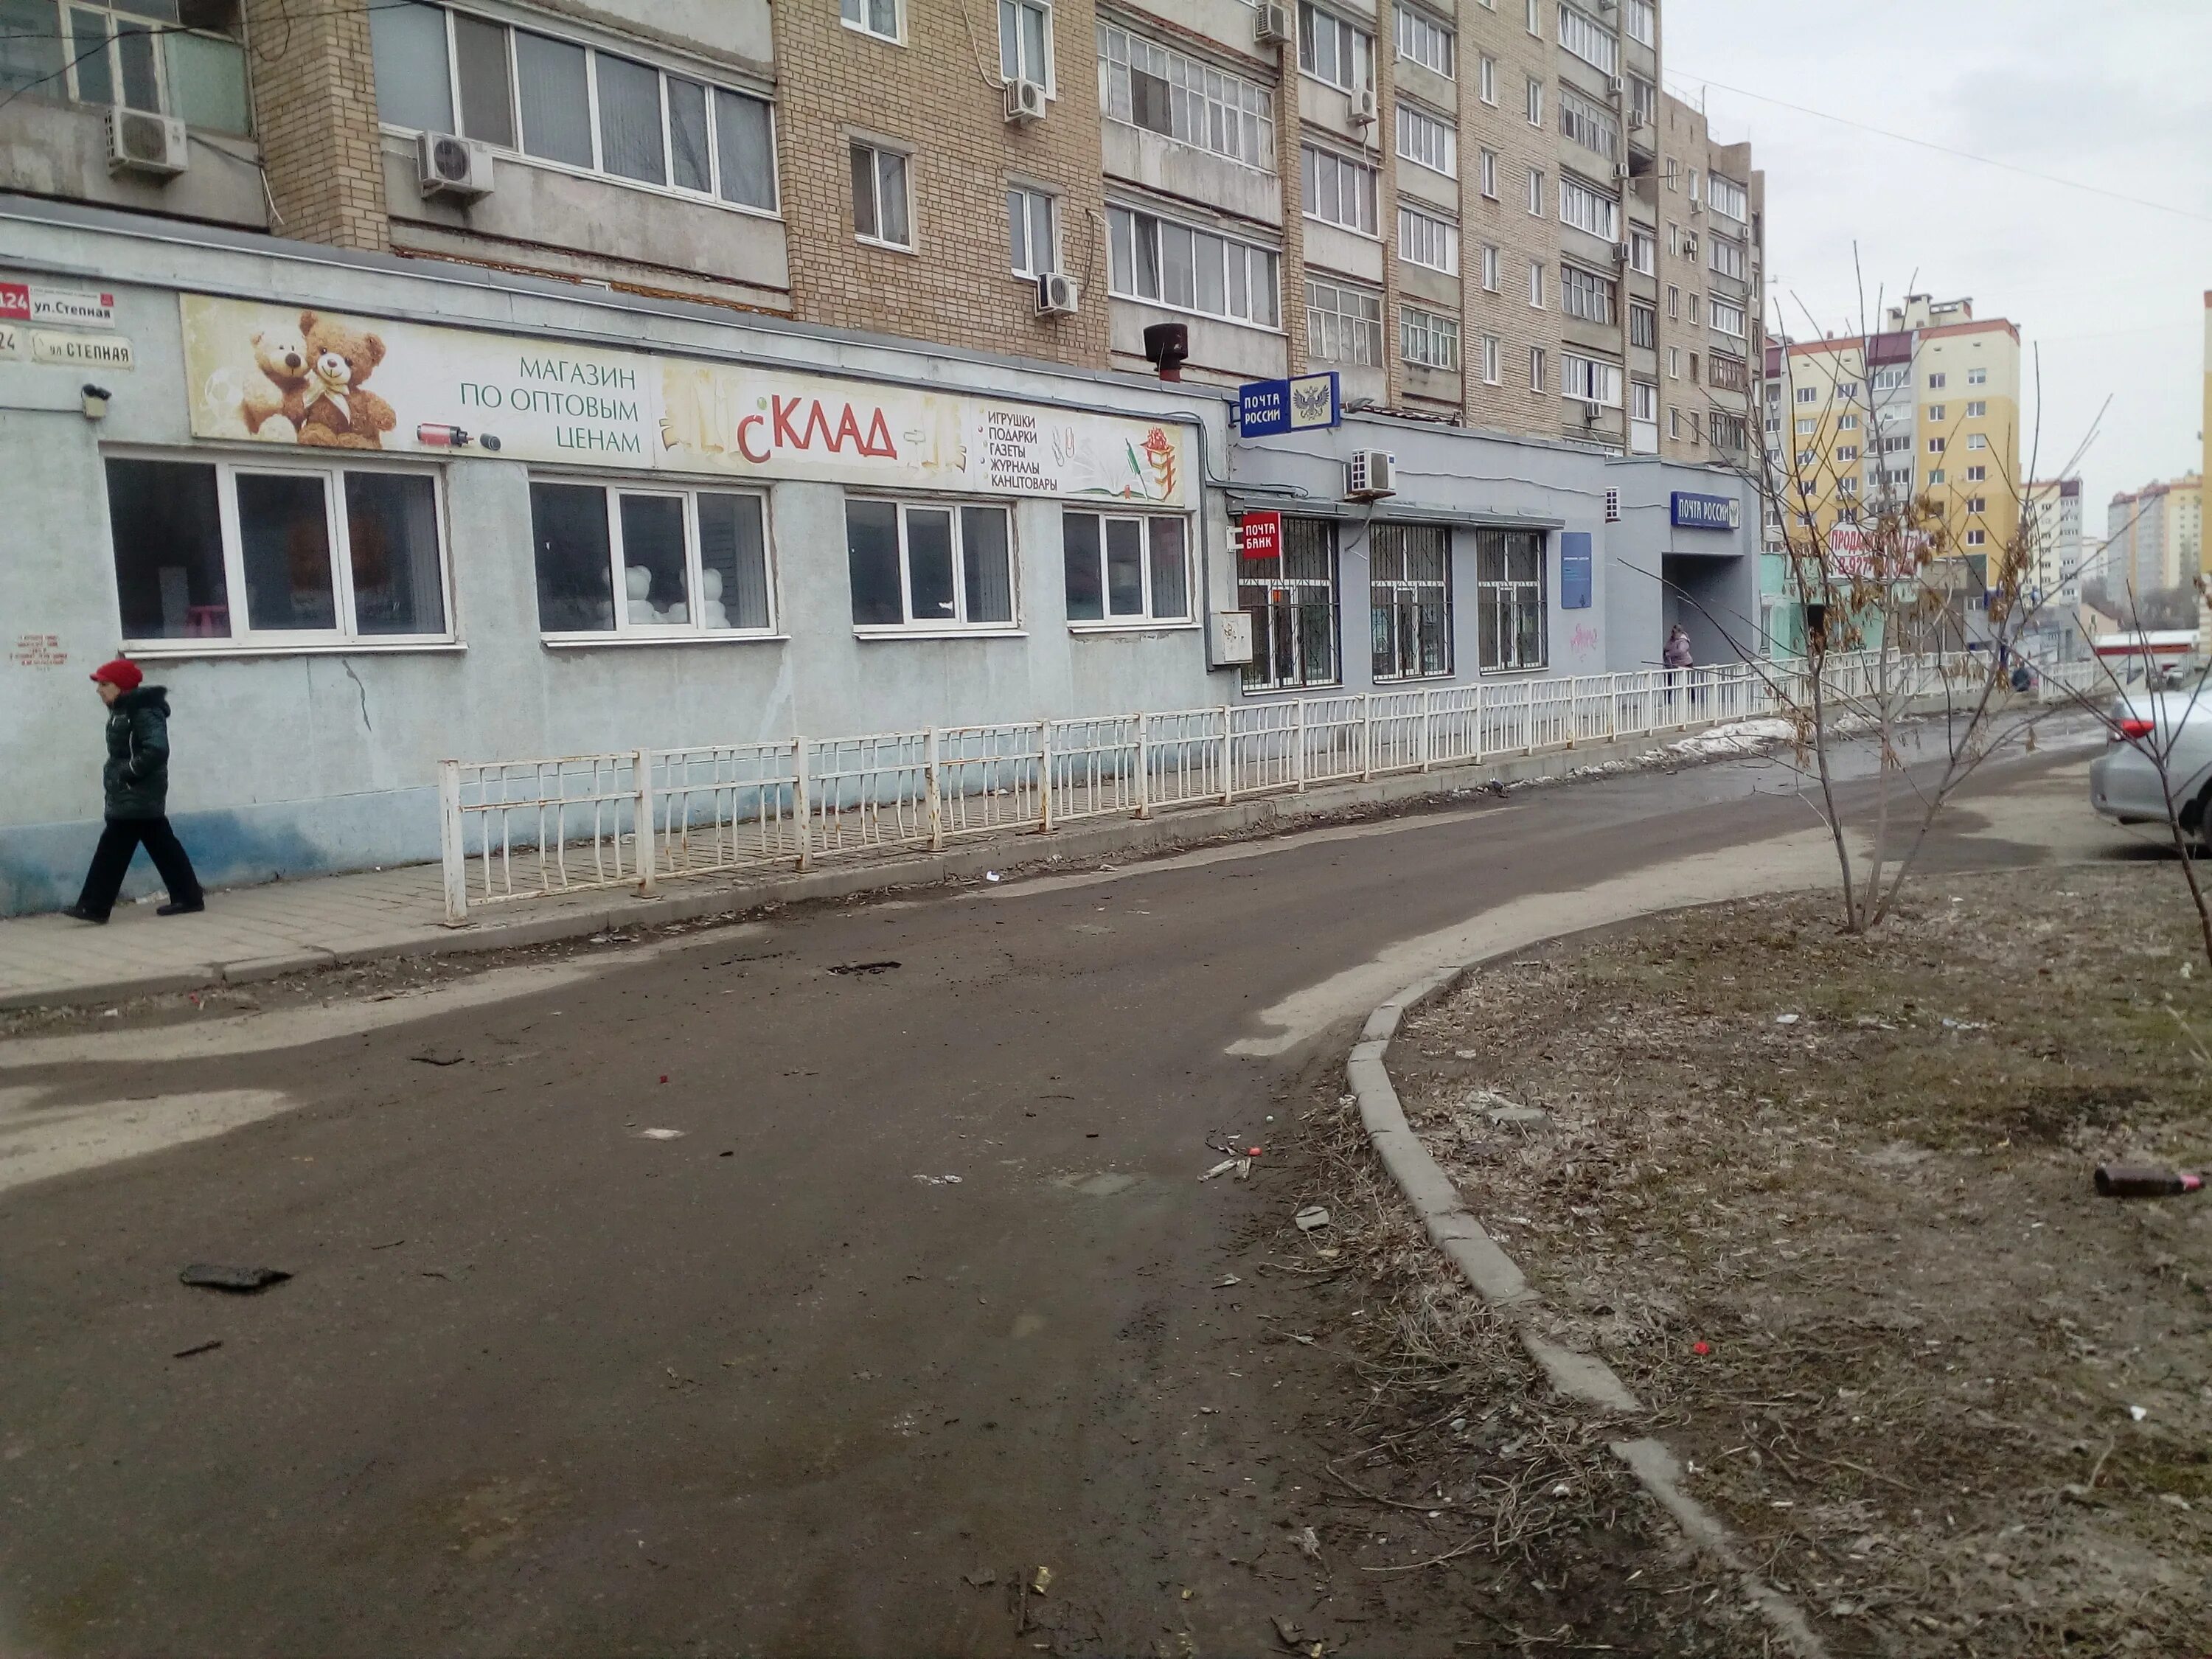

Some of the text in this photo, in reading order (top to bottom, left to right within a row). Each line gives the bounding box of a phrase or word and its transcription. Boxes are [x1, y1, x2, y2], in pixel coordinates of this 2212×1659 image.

[35, 301, 111, 319] ул.Степная
[67, 342, 129, 362] СТЕПНАЯ
[520, 356, 636, 390] МАГАЗИН
[460, 383, 639, 422] ПО ОПТОВЫМ
[1245, 393, 1280, 408] ПОЧТА
[988, 411, 1035, 428] ИГРУШКИ
[1245, 408, 1281, 425] РОССИИ
[557, 425, 641, 453] ЦЕНАМ
[989, 427, 1037, 444] ПОДАРКИ
[990, 443, 1026, 458] ГАЗЕТЫ
[990, 459, 1040, 474] ЖУРНАЛЫ
[991, 474, 1057, 490] КАНЦТОВАРЫ
[1678, 498, 1729, 522] ПОЧТА РОССИИ
[1245, 523, 1276, 537] ПОЧТА
[1246, 537, 1272, 549] БАНК
